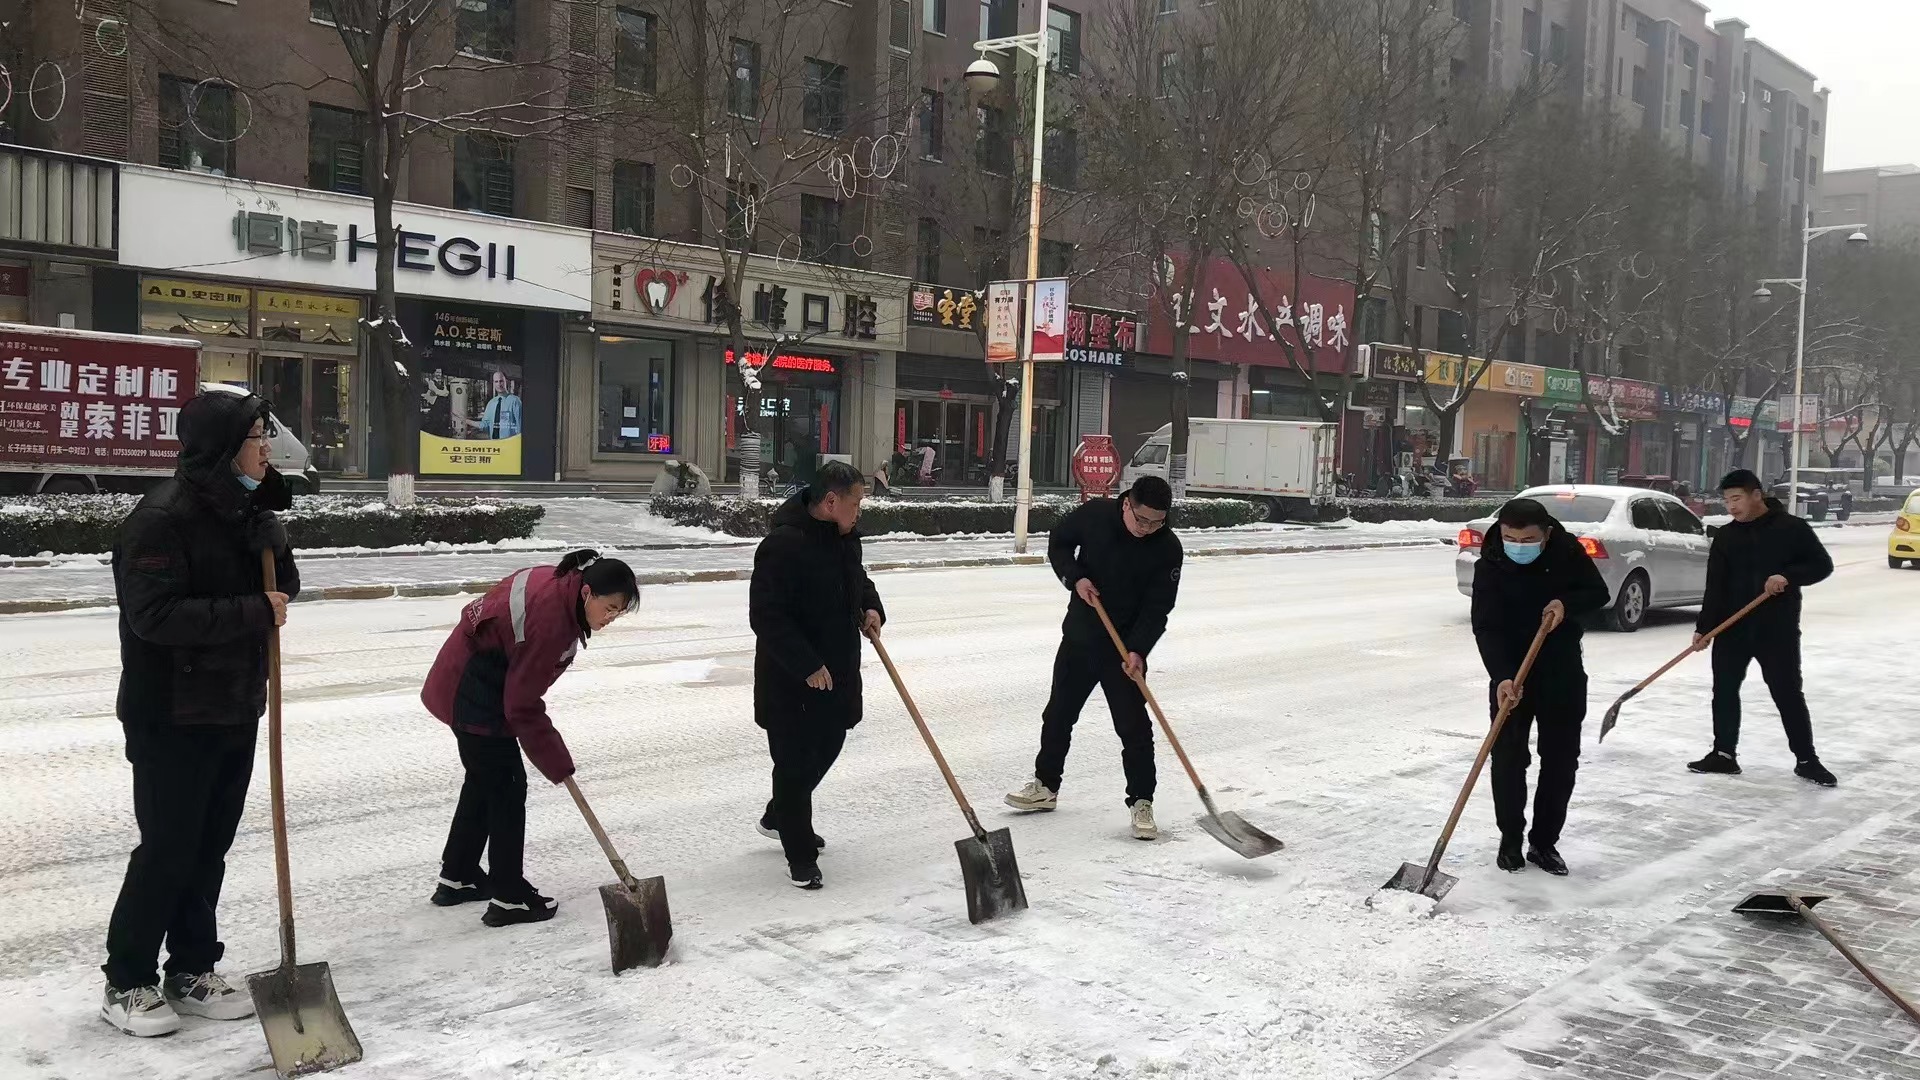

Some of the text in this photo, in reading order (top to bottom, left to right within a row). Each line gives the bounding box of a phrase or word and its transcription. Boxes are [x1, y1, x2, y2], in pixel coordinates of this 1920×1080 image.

[349, 223, 516, 281] HEGII
[434, 324, 502, 342] A.O.史密斯
[2, 356, 178, 400] 专业定制柜
[84, 400, 181, 440] 索菲亚
[650, 436, 669, 452] 牙科
[449, 455, 492, 464] 史密斯
